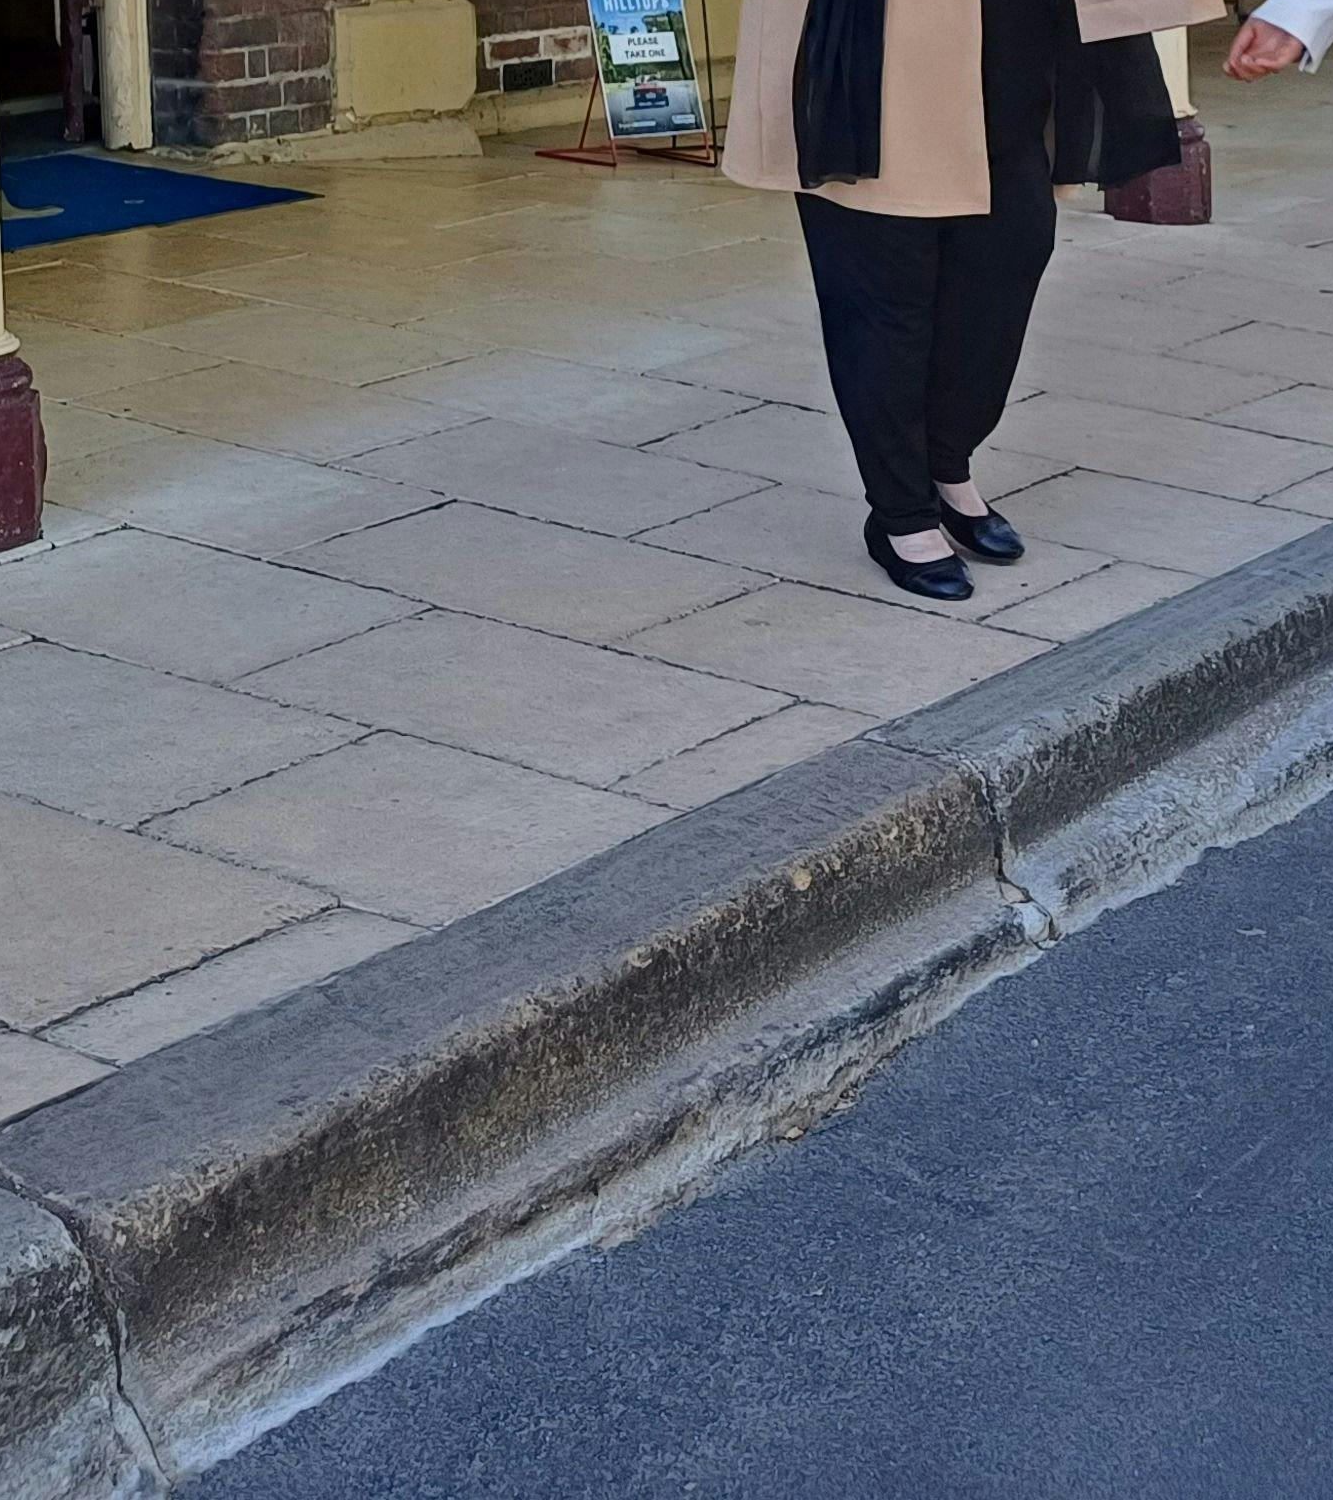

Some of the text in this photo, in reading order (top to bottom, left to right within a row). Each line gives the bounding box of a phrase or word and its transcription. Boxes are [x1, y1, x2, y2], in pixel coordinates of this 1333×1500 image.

[627, 36, 659, 46] PLEASE
[625, 49, 666, 59] TAKE ONE
